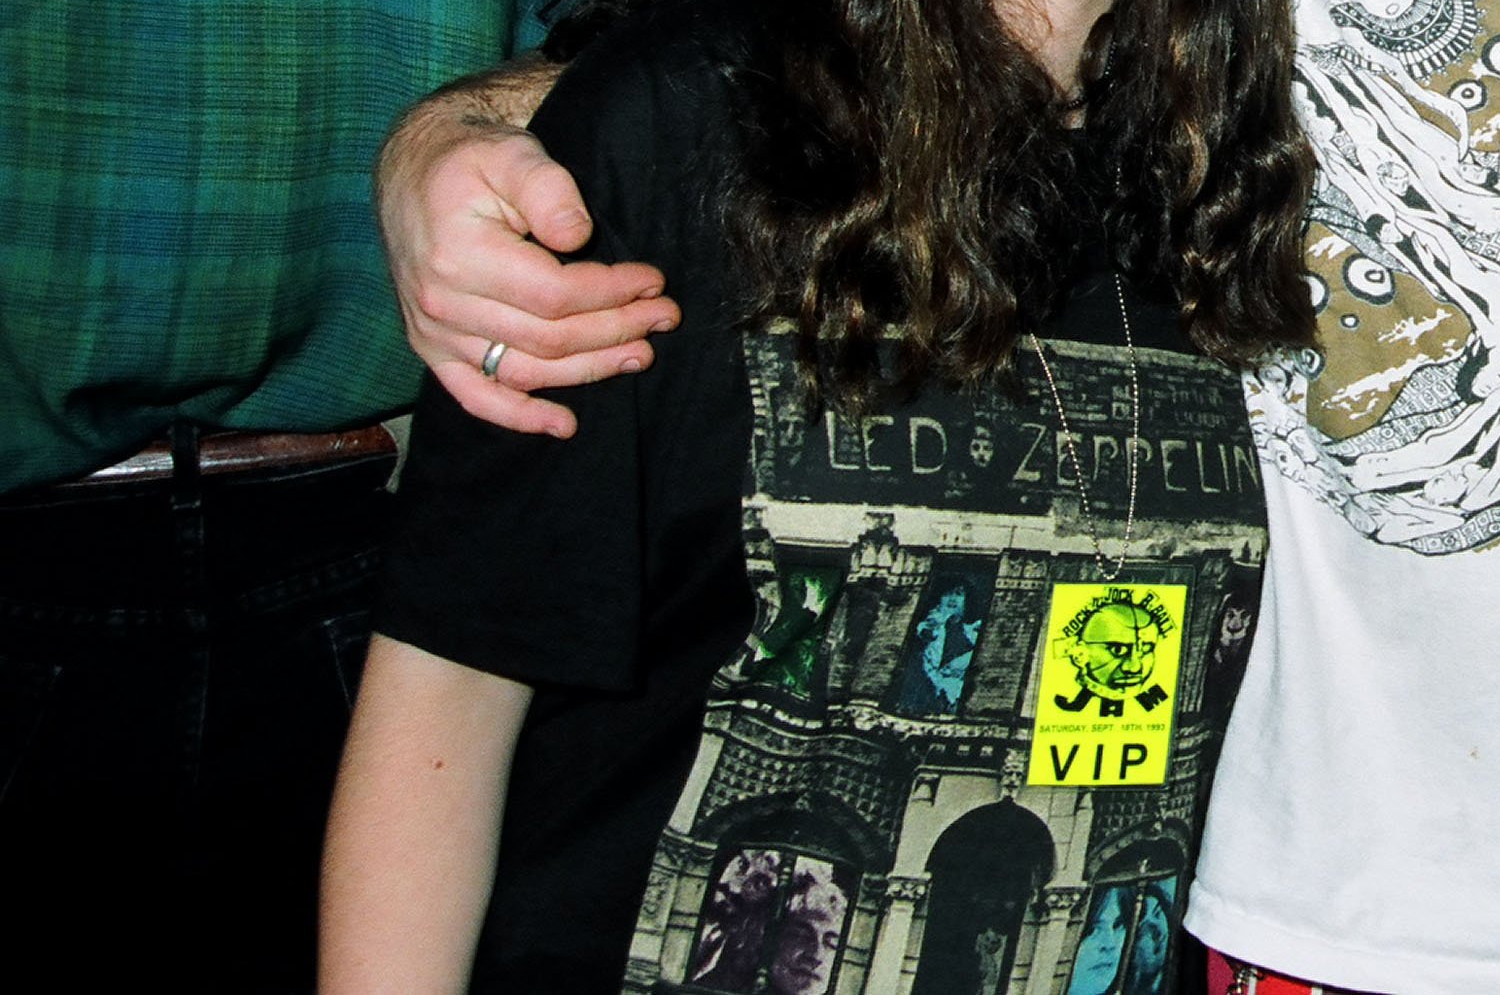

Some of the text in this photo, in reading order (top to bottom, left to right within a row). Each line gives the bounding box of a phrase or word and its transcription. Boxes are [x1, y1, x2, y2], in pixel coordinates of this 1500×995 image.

[825, 409, 1261, 494] LED ZEPPELIN
[1062, 606, 1092, 637] ROCK
[1104, 587, 1134, 604] JOCK
[1055, 684, 1168, 717] JAM
[1049, 742, 1148, 781] VIP
